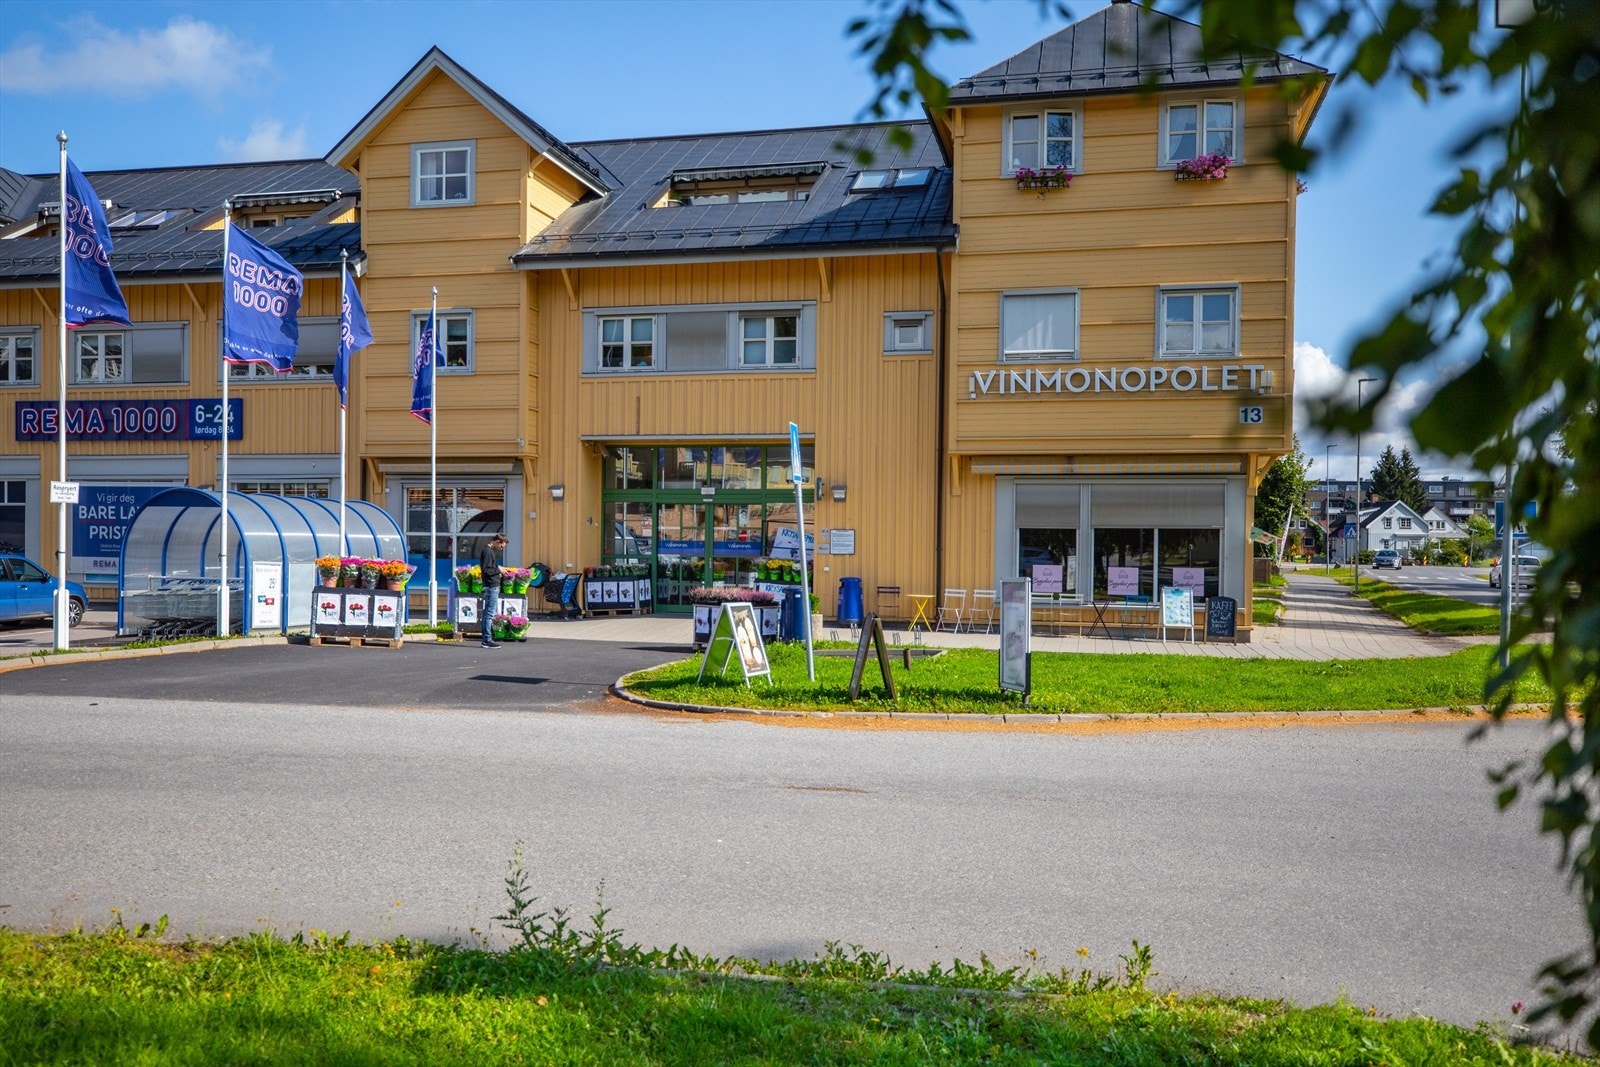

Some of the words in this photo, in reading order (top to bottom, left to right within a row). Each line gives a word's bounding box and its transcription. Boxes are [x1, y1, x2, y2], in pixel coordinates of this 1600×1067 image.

[229, 252, 299, 296] REMA
[233, 280, 289, 317] 1000
[76, 305, 93, 316] ofte
[973, 365, 1265, 394] VINMONOPOLET
[21, 408, 105, 433] REMA
[111, 407, 176, 433] 1000
[195, 404, 234, 423] 6-24
[1240, 408, 1262, 423] 13
[195, 426, 217, 435] lørdag
[97, 493, 105, 502] Vi
[106, 494, 118, 504] gir
[120, 493, 135, 504] deg
[79, 506, 117, 520] BARE
[120, 506, 140, 520] LA
[93, 560, 117, 568] REMA
[1211, 600, 1234, 611] KAFFE
